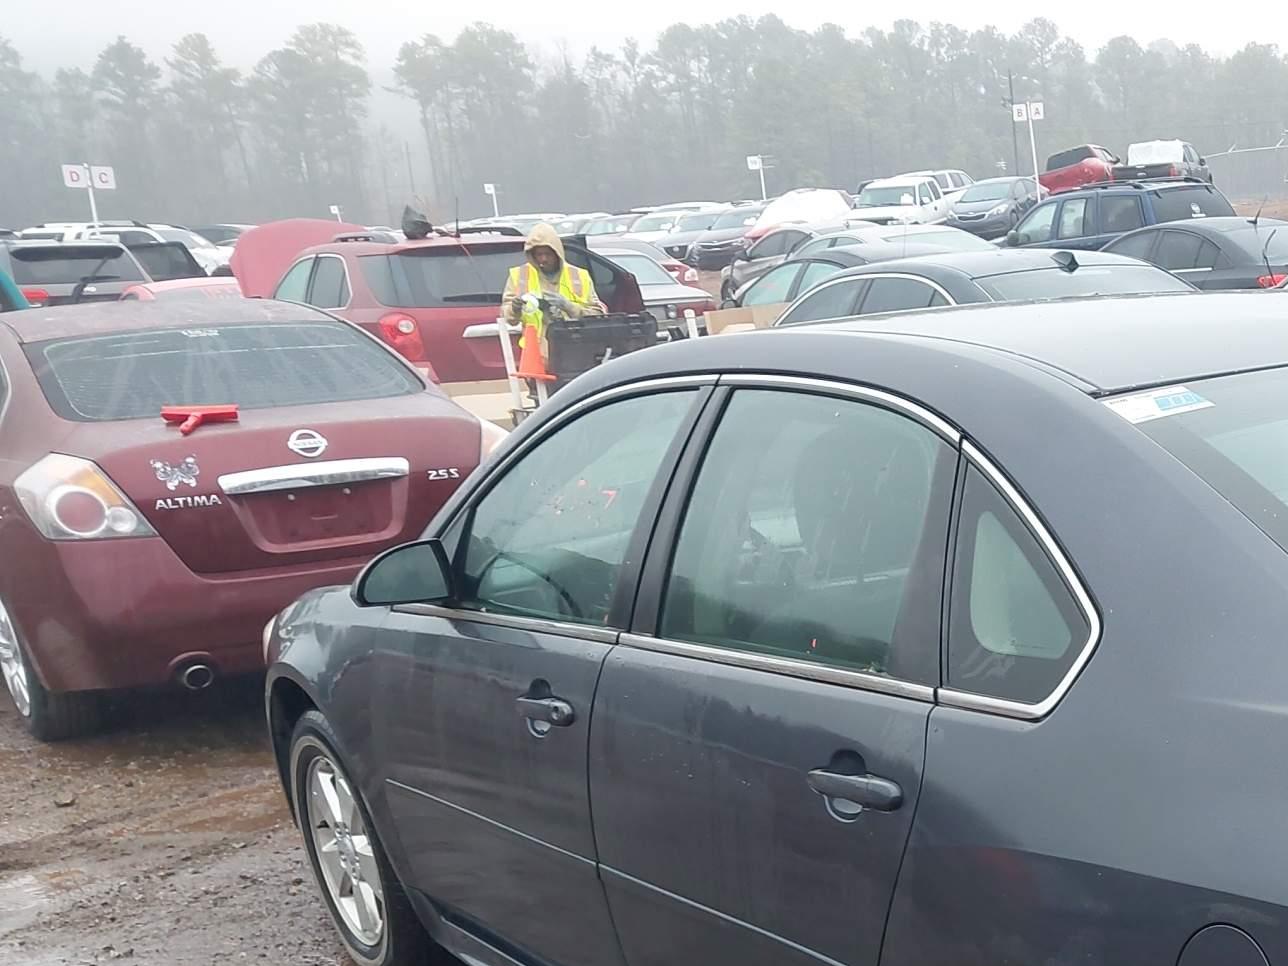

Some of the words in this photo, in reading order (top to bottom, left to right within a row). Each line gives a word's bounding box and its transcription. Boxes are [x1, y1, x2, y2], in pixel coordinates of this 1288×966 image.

[70, 170, 80, 182] D
[98, 172, 109, 183] C
[155, 494, 222, 510] ALTIMA
